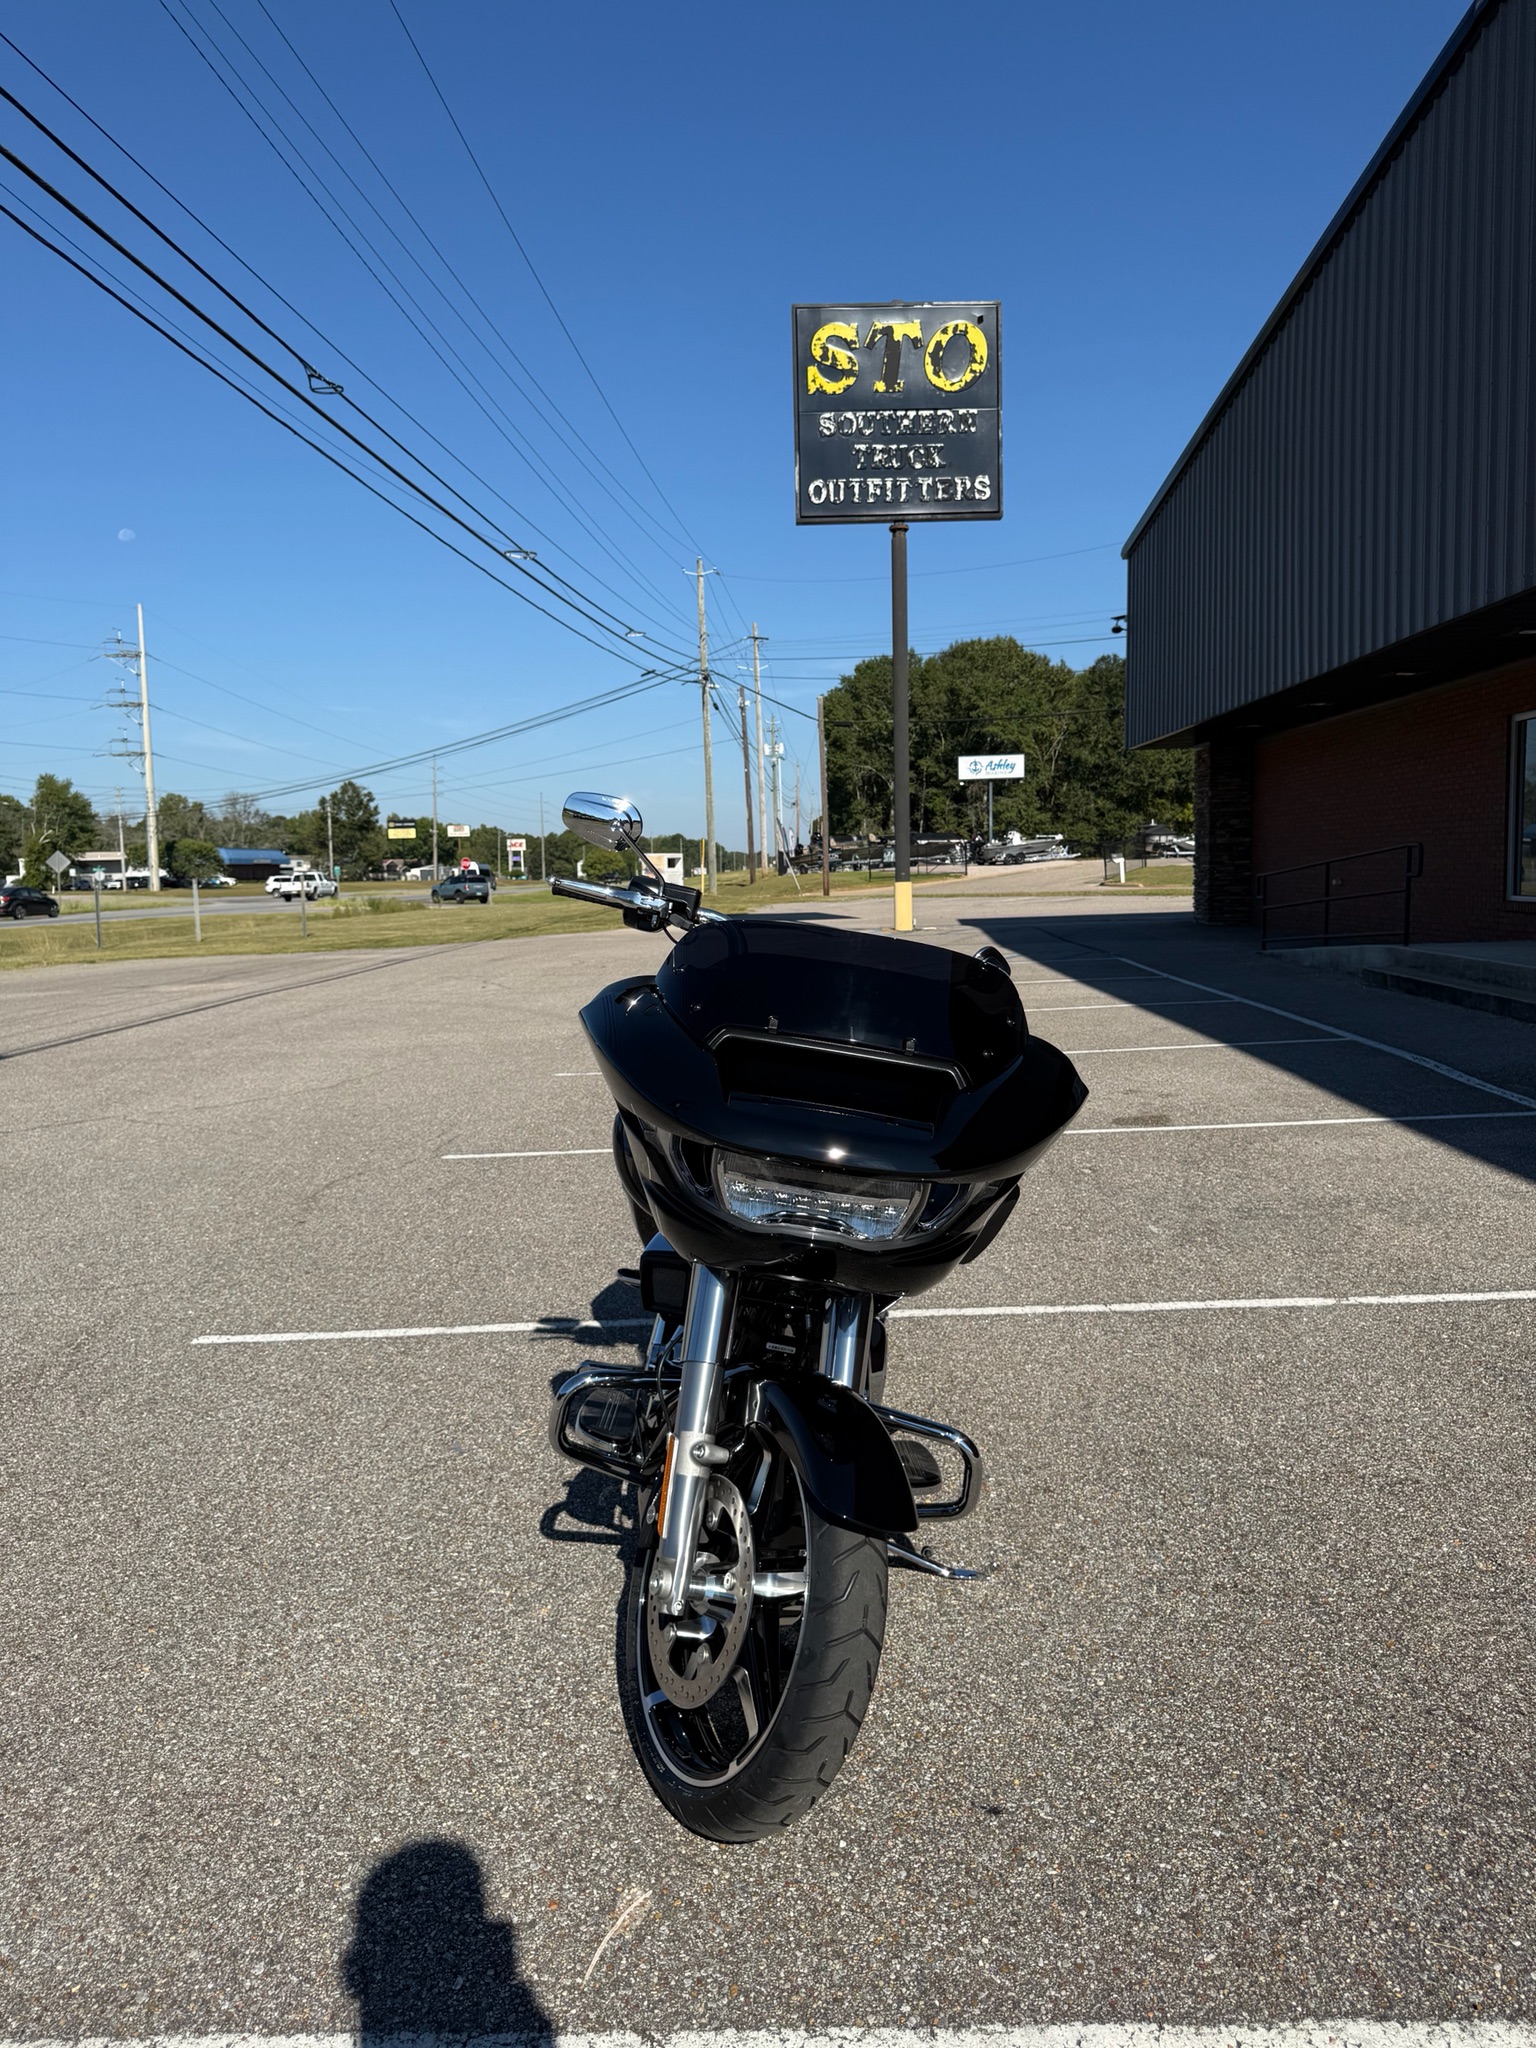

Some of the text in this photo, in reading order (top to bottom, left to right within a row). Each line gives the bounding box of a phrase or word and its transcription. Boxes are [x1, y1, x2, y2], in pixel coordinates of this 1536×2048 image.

[807, 319, 988, 395] STO
[818, 409, 978, 437] SOUTHERN
[852, 443, 946, 470] TRUCK
[807, 475, 991, 505] OUTFITTERS
[985, 759, 1016, 773] Ashley
